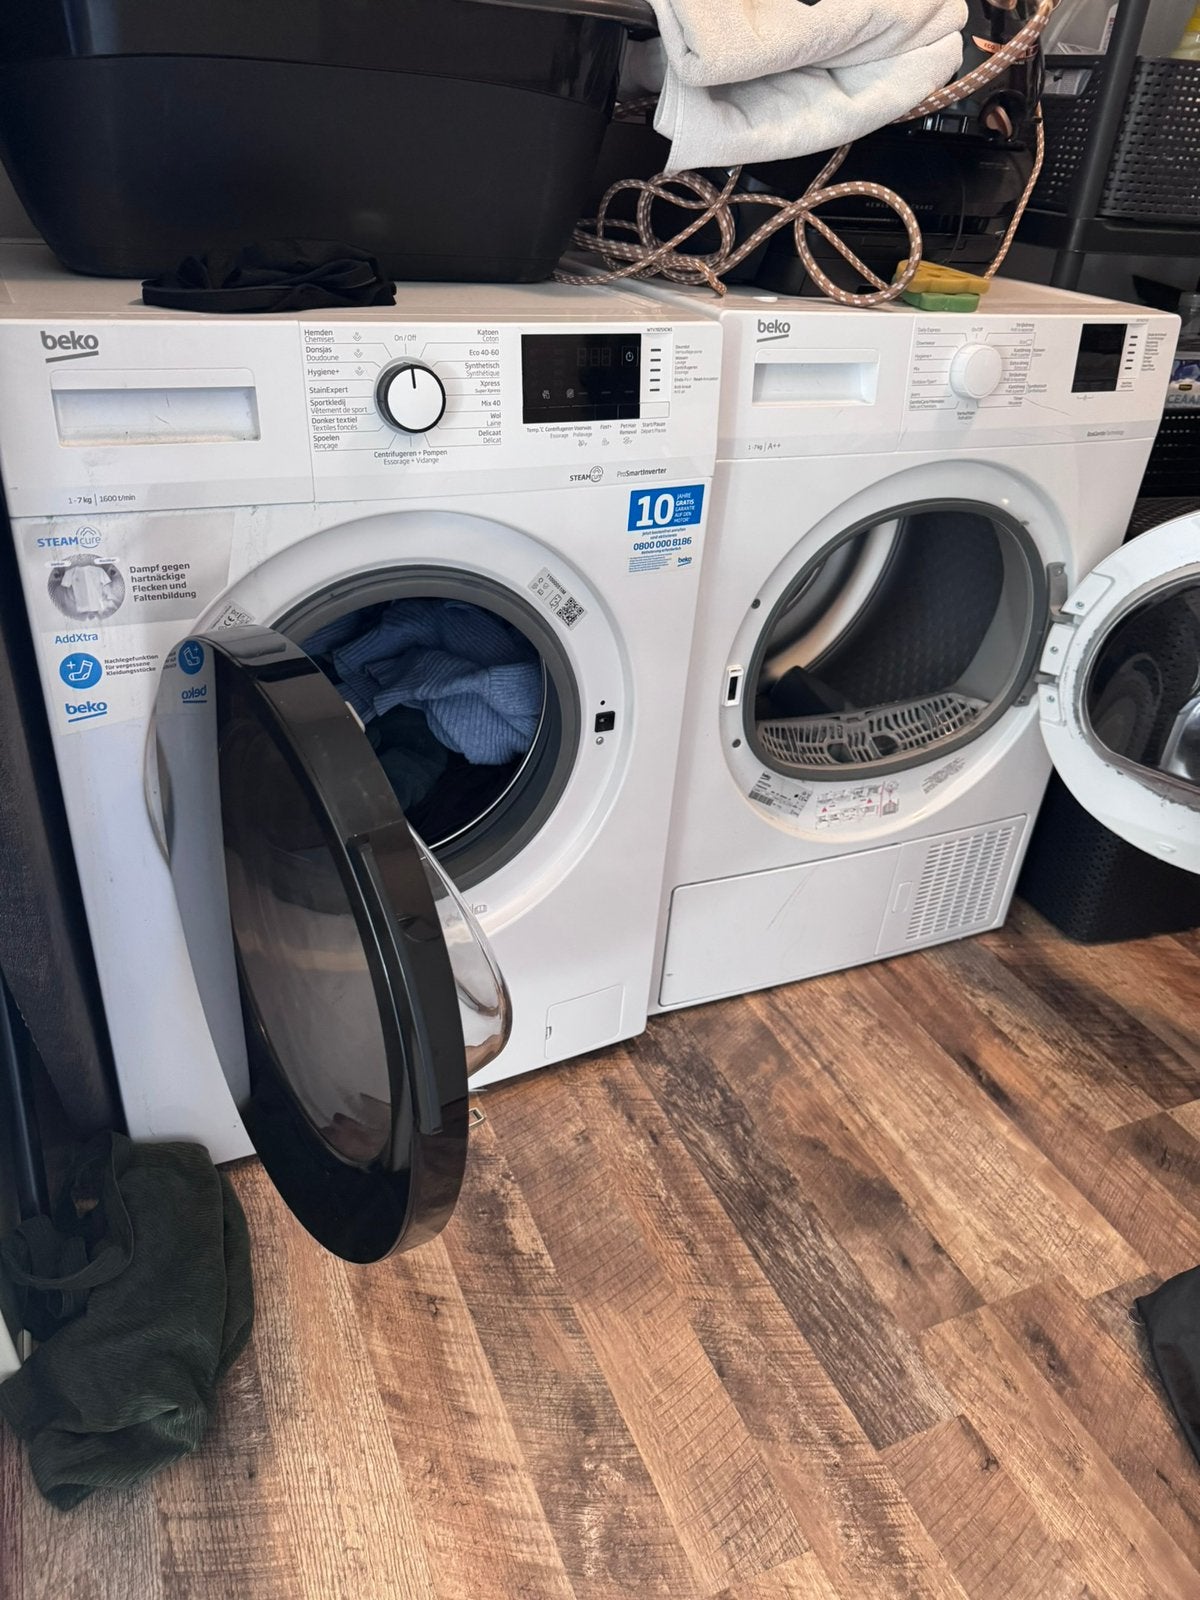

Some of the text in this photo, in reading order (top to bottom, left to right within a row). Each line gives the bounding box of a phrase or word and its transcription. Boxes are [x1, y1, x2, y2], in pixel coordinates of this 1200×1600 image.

[757, 319, 790, 333] beko
[40, 331, 98, 350] beko
[306, 346, 332, 354] Donsjas
[308, 368, 339, 376] Hygiene+
[309, 386, 348, 394] StainExpert
[310, 399, 346, 407] Sportkledij
[423, 450, 447, 458] Pompen
[617, 468, 667, 477] ProSmartInverter
[83, 496, 92, 504] kg
[118, 494, 136, 502] t/min
[636, 494, 674, 527] 10
[634, 537, 692, 550] 0800 000 8186
[129, 563, 190, 574] Dampf gegen
[131, 573, 186, 583] hartnäckige
[132, 582, 187, 593] Flecken und
[134, 591, 196, 602] Faltenbildung
[55, 633, 98, 644] AddXtra
[104, 654, 159, 664] Nachlegefunktion
[106, 667, 156, 676] Kleidungsstücke
[65, 701, 107, 715] beko
